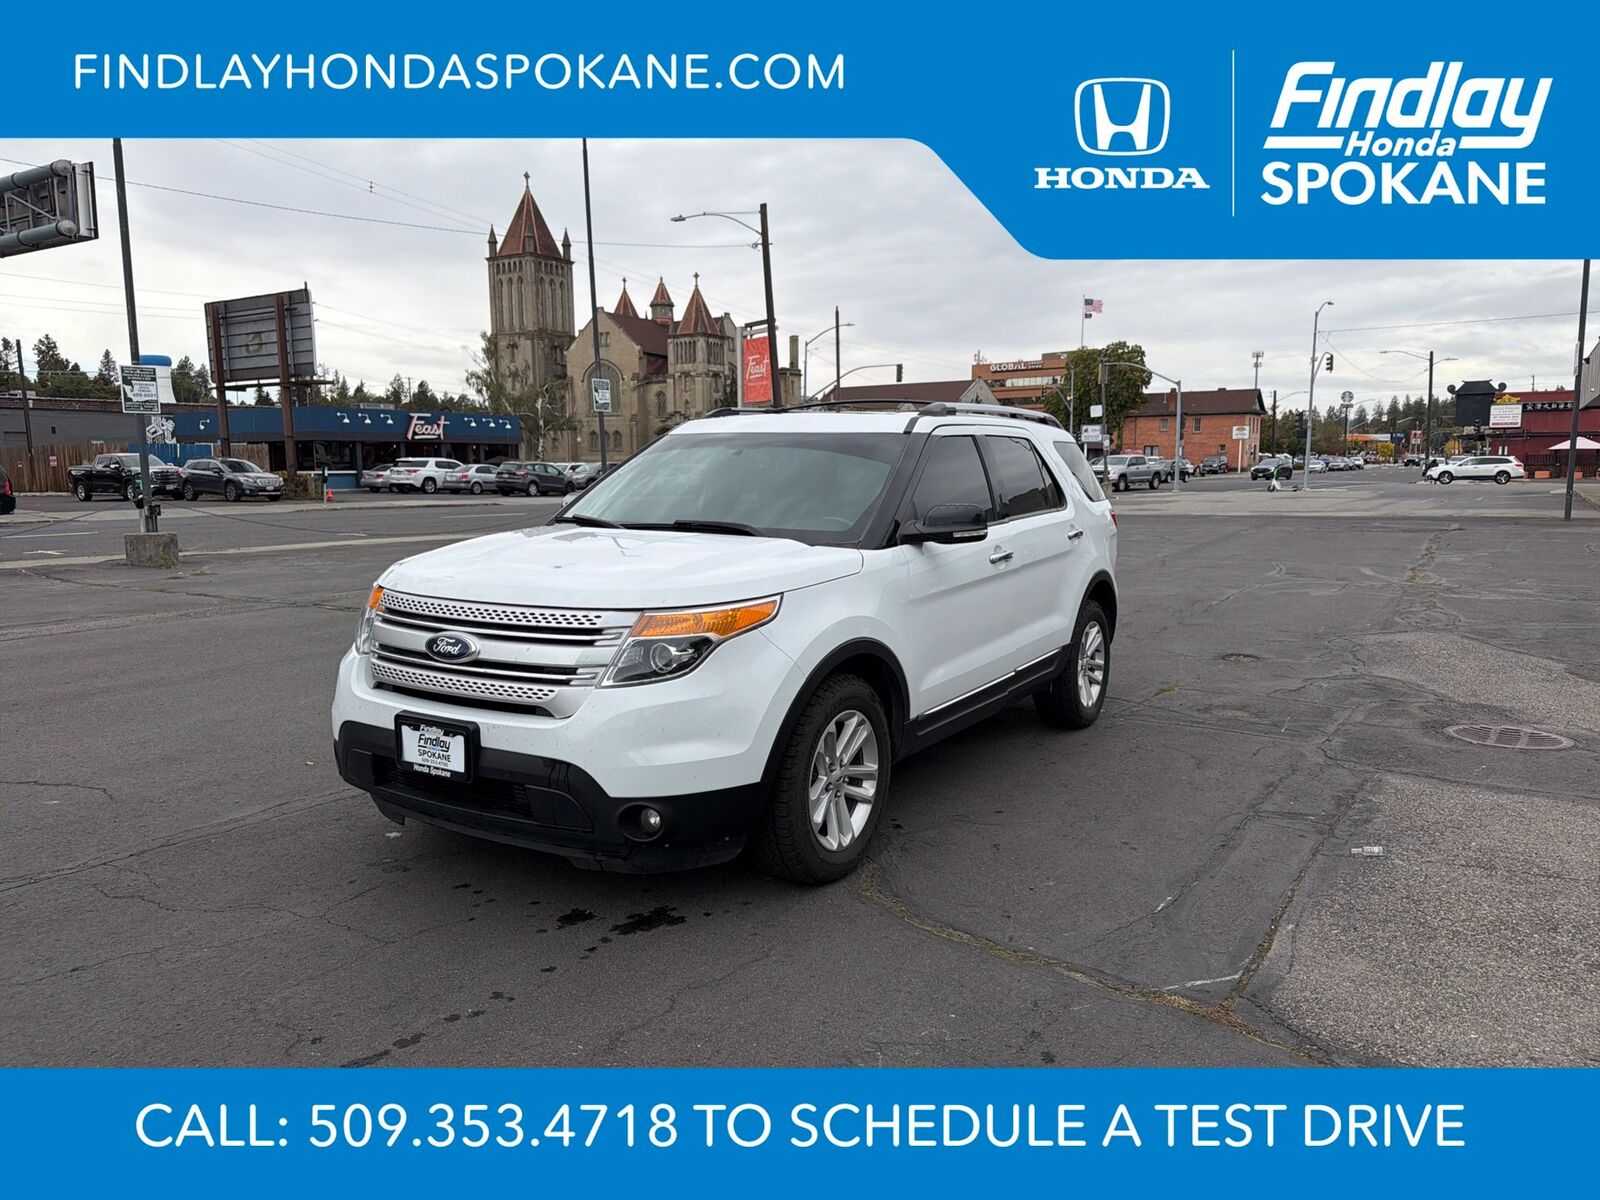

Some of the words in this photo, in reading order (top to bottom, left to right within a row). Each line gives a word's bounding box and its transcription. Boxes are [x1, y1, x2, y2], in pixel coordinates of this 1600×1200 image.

[746, 355, 770, 380] Feast
[990, 361, 1027, 372] GLOBAL
[406, 412, 451, 440] Feast
[432, 636, 462, 655] Ford
[417, 733, 451, 753] Findlay
[417, 748, 452, 763] SPOKANE
[413, 764, 430, 774] Honda
[430, 766, 451, 778] Spokane
